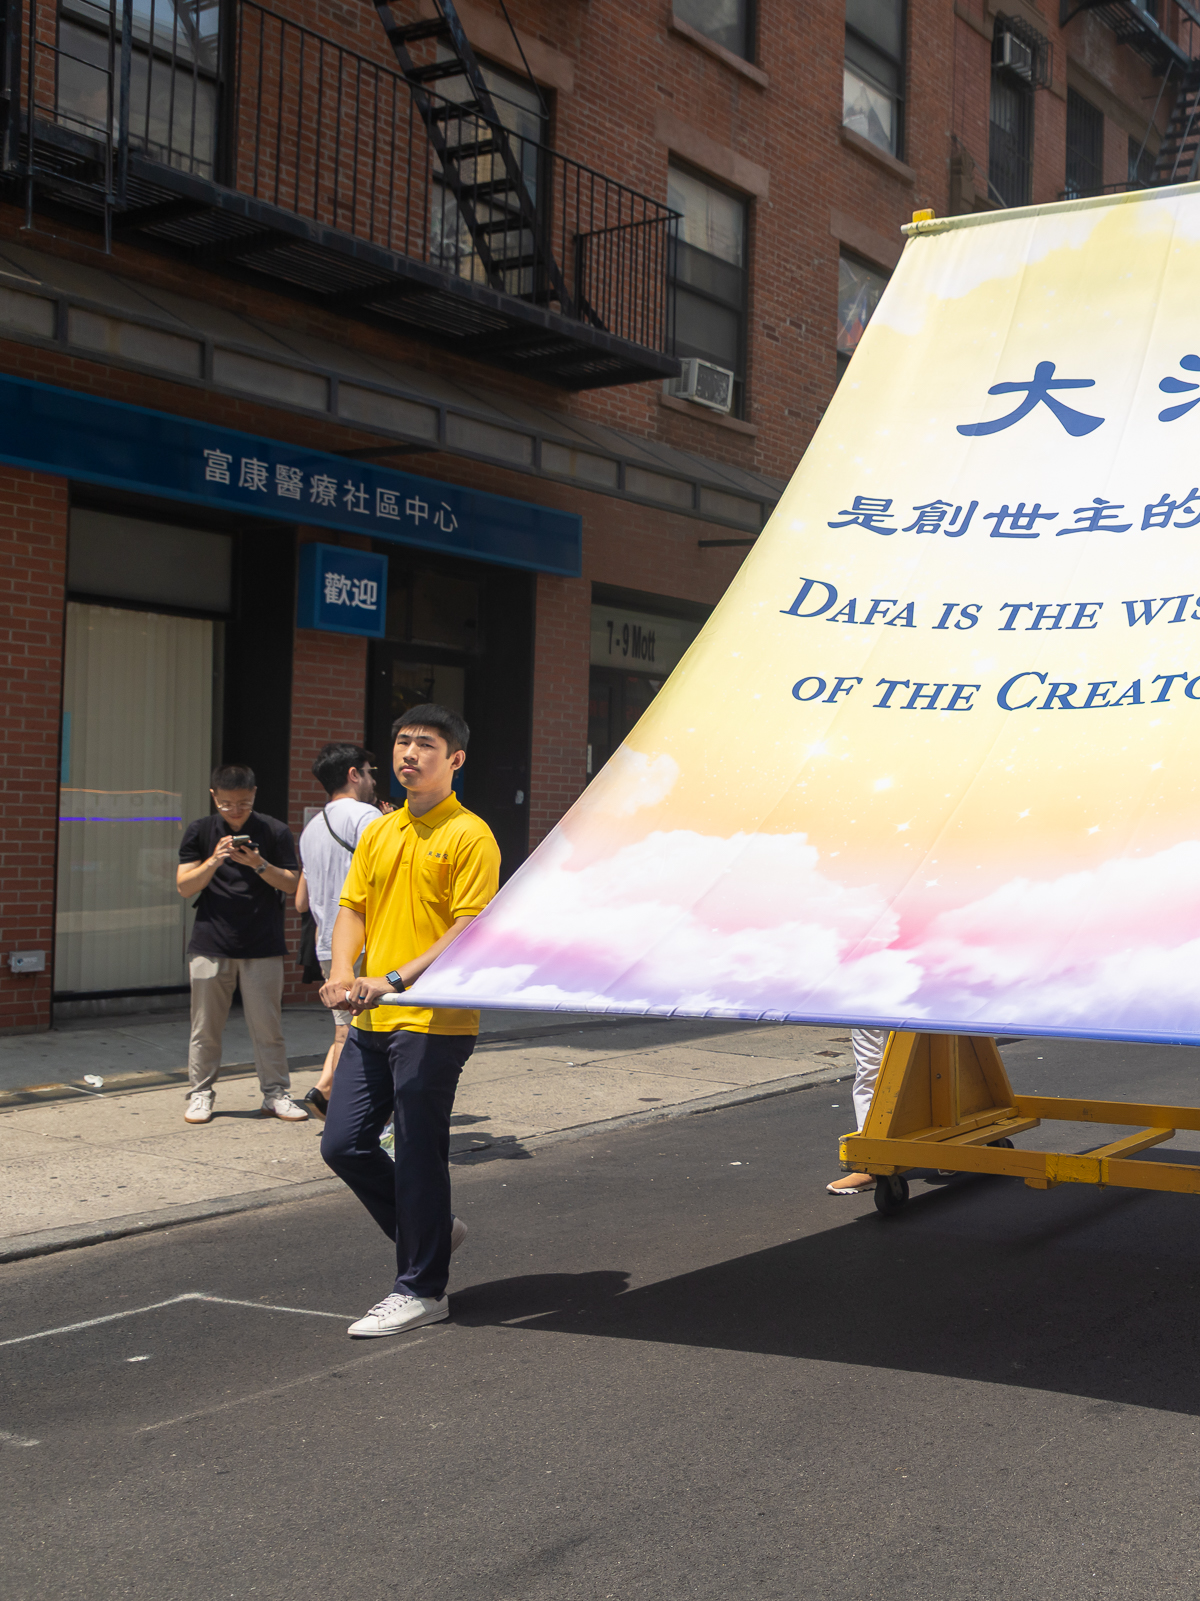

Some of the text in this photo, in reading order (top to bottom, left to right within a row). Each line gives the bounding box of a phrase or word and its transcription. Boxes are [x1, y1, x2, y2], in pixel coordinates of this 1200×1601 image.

[203, 449, 458, 533] 富康醫療社區中心
[324, 571, 378, 610] 歡迎
[780, 577, 917, 630] DAFA
[932, 603, 982, 631] IS
[998, 602, 1103, 632] THE
[631, 624, 656, 662] Mott
[791, 676, 862, 705] OF
[874, 678, 981, 712] THE
